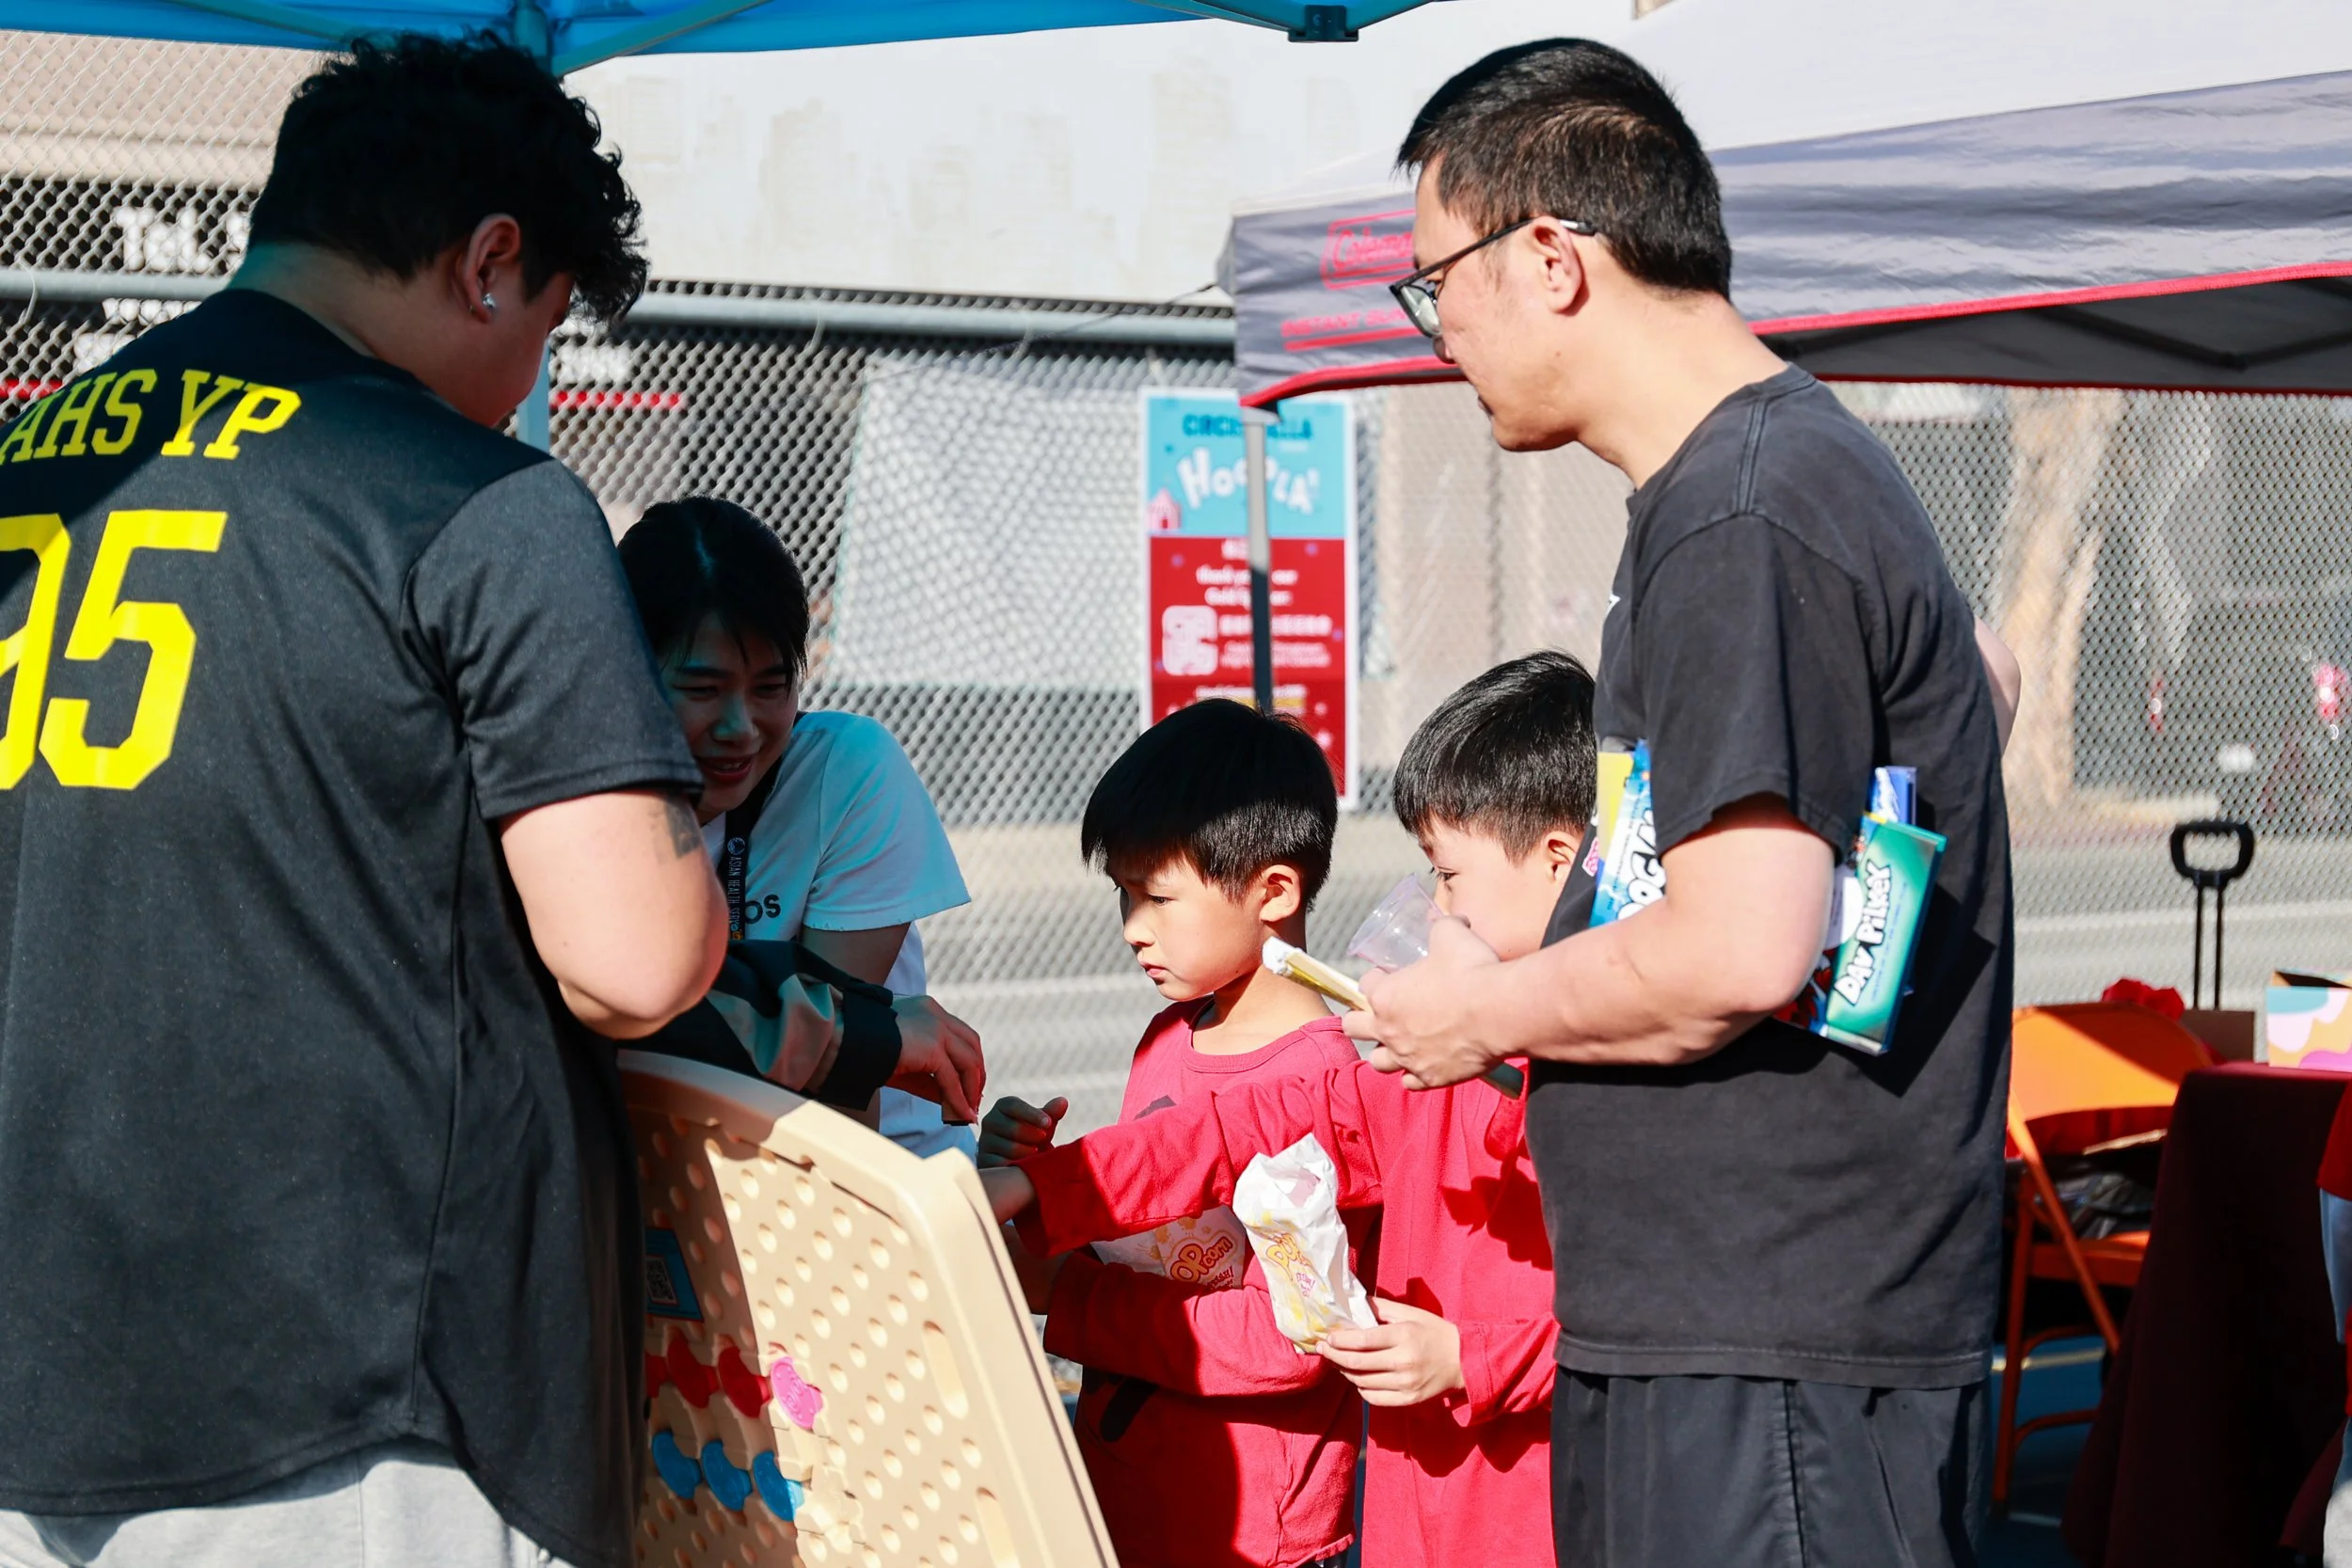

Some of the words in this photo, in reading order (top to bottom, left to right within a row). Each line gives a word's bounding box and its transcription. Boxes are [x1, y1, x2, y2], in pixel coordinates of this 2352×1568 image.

[1332, 227, 1414, 270] Colema
[0, 369, 157, 466] AHS
[161, 369, 301, 460] YP
[728, 879, 740, 904] HEALTH
[1835, 945, 1875, 1006] DAV
[1170, 1236, 1233, 1282] OPcorn
